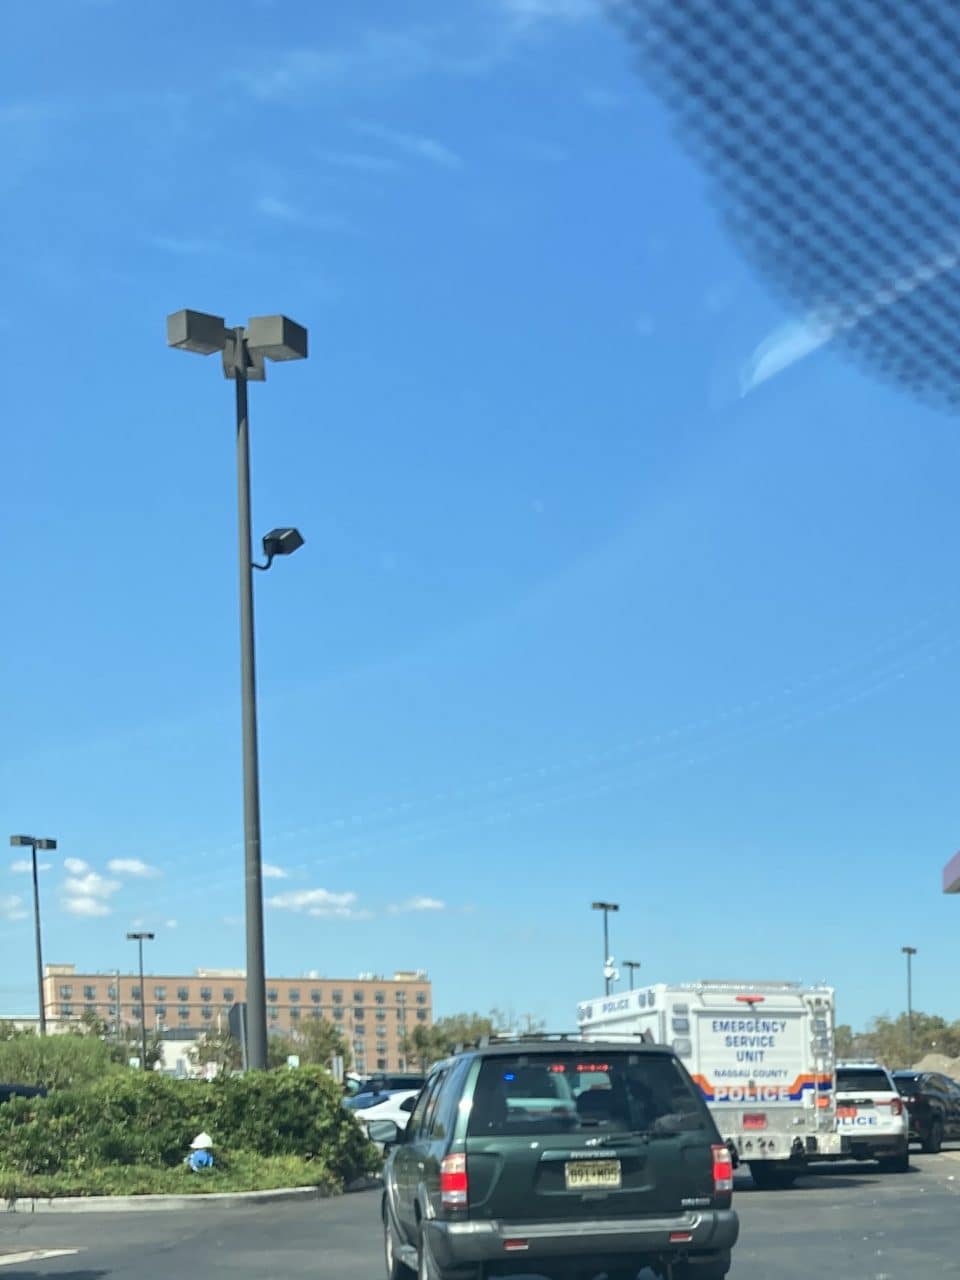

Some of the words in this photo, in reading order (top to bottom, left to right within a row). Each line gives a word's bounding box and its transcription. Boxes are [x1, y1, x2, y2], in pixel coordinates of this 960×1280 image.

[602, 998, 629, 1013] POLICE
[712, 1020, 786, 1033] EMERGENCY
[725, 1035, 775, 1048] SERVICE
[736, 1050, 764, 1062] UNIT
[714, 1069, 750, 1078] NASSAU
[752, 1069, 788, 1078] COUNTY
[714, 1086, 790, 1102] POLICE
